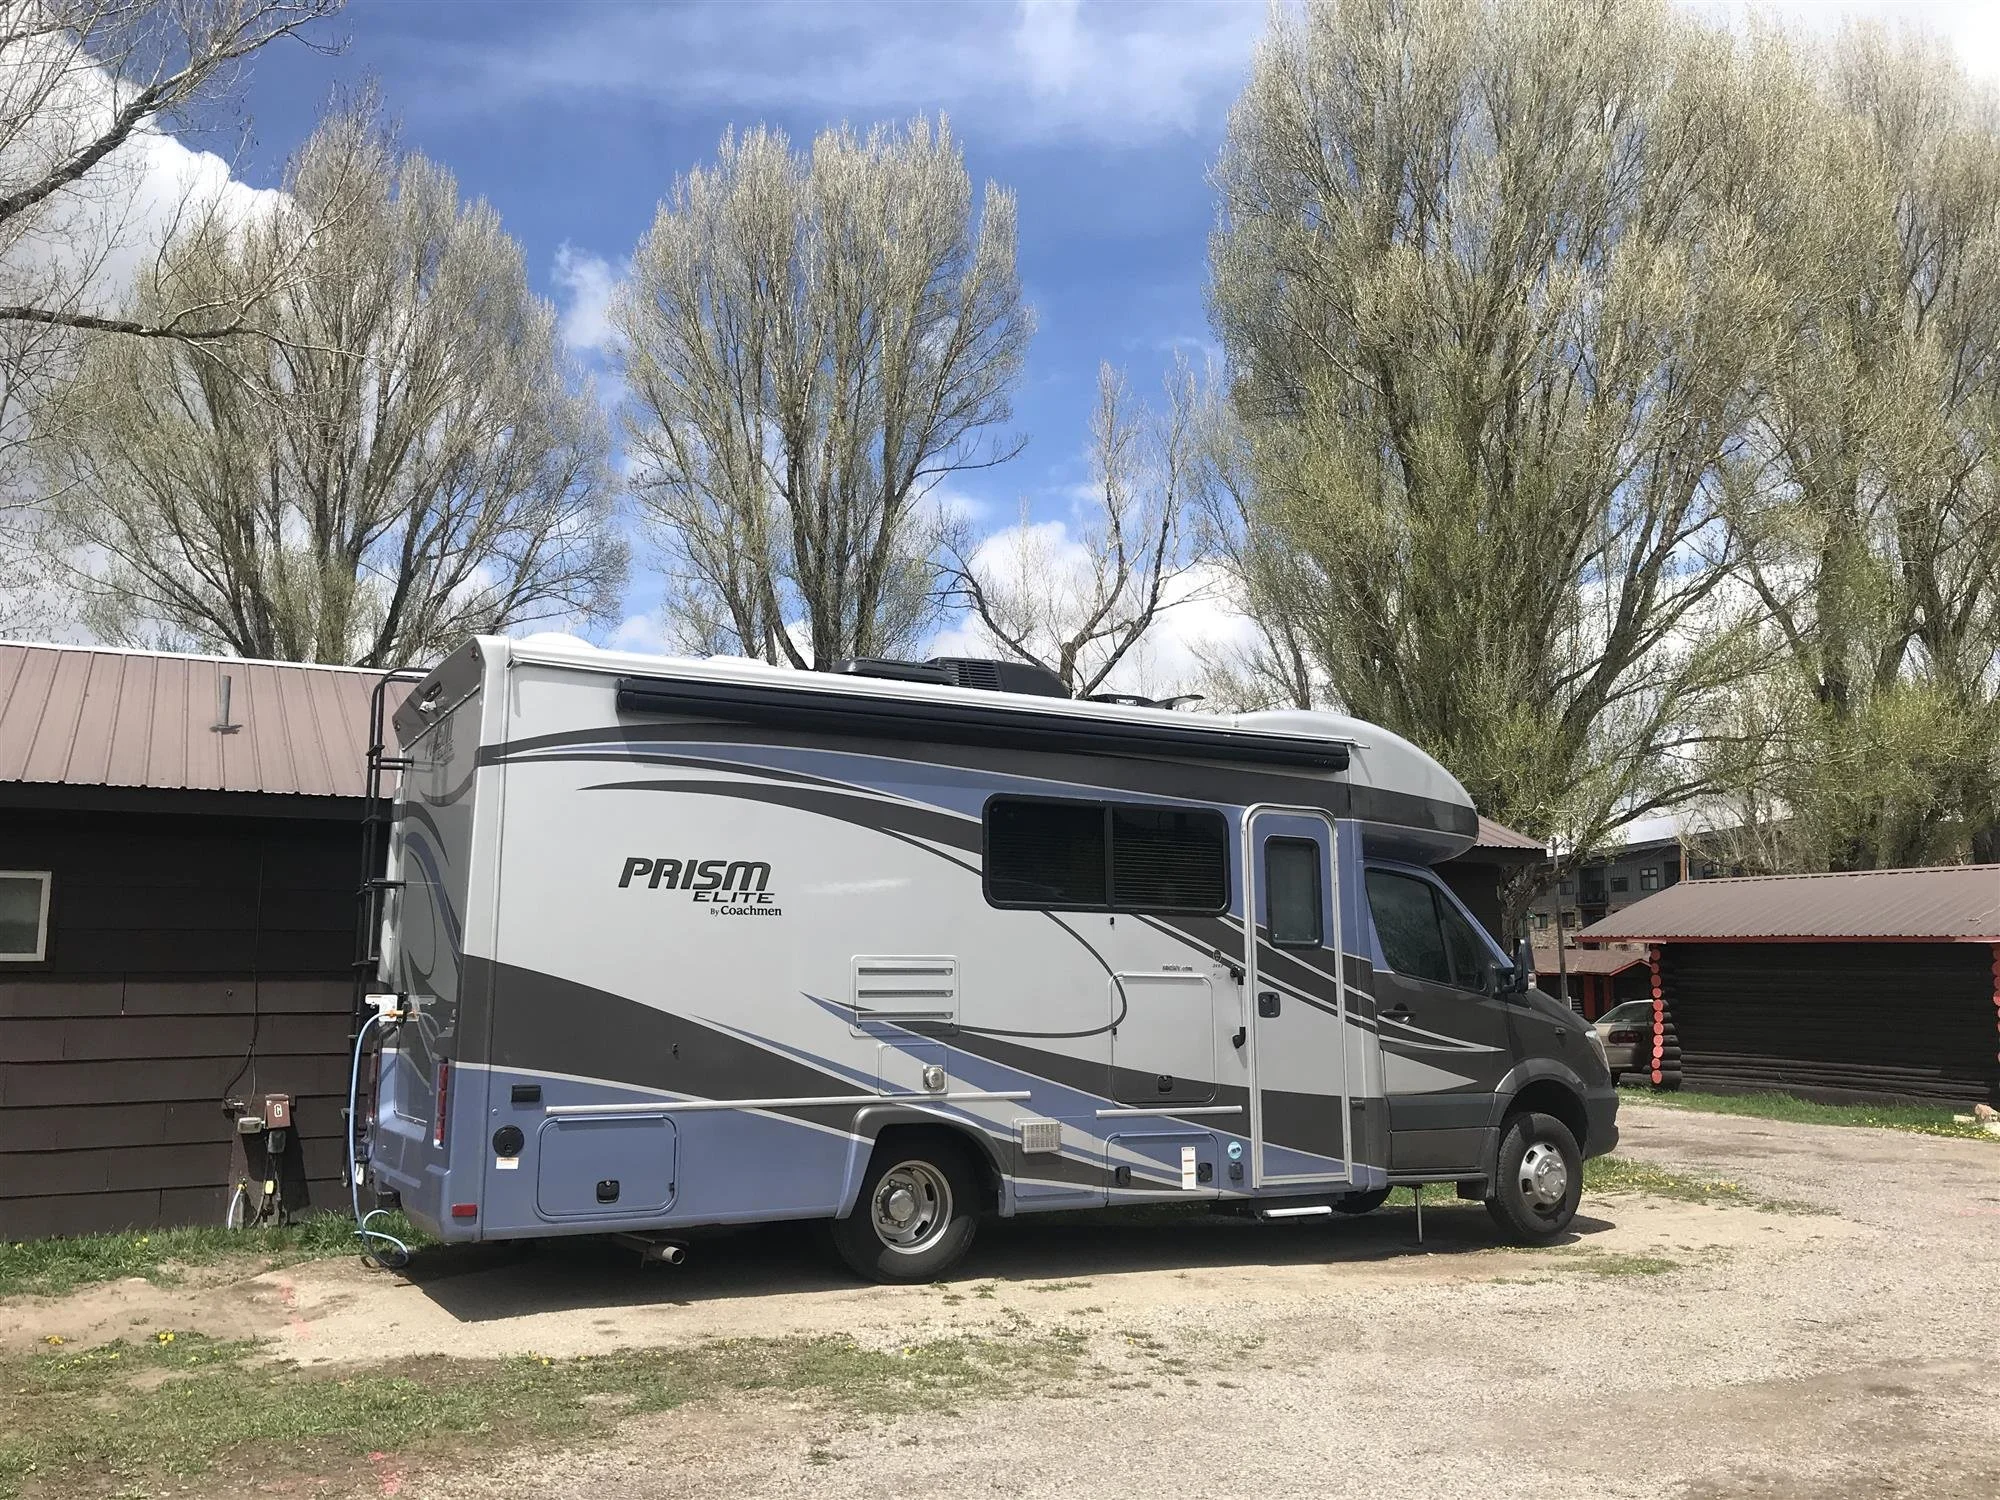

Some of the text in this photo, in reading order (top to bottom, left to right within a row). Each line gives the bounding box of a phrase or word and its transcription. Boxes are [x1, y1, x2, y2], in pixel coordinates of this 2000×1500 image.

[618, 857, 771, 891] PRISM
[693, 891, 775, 903] ELITE
[710, 905, 782, 917] By Coachmen
